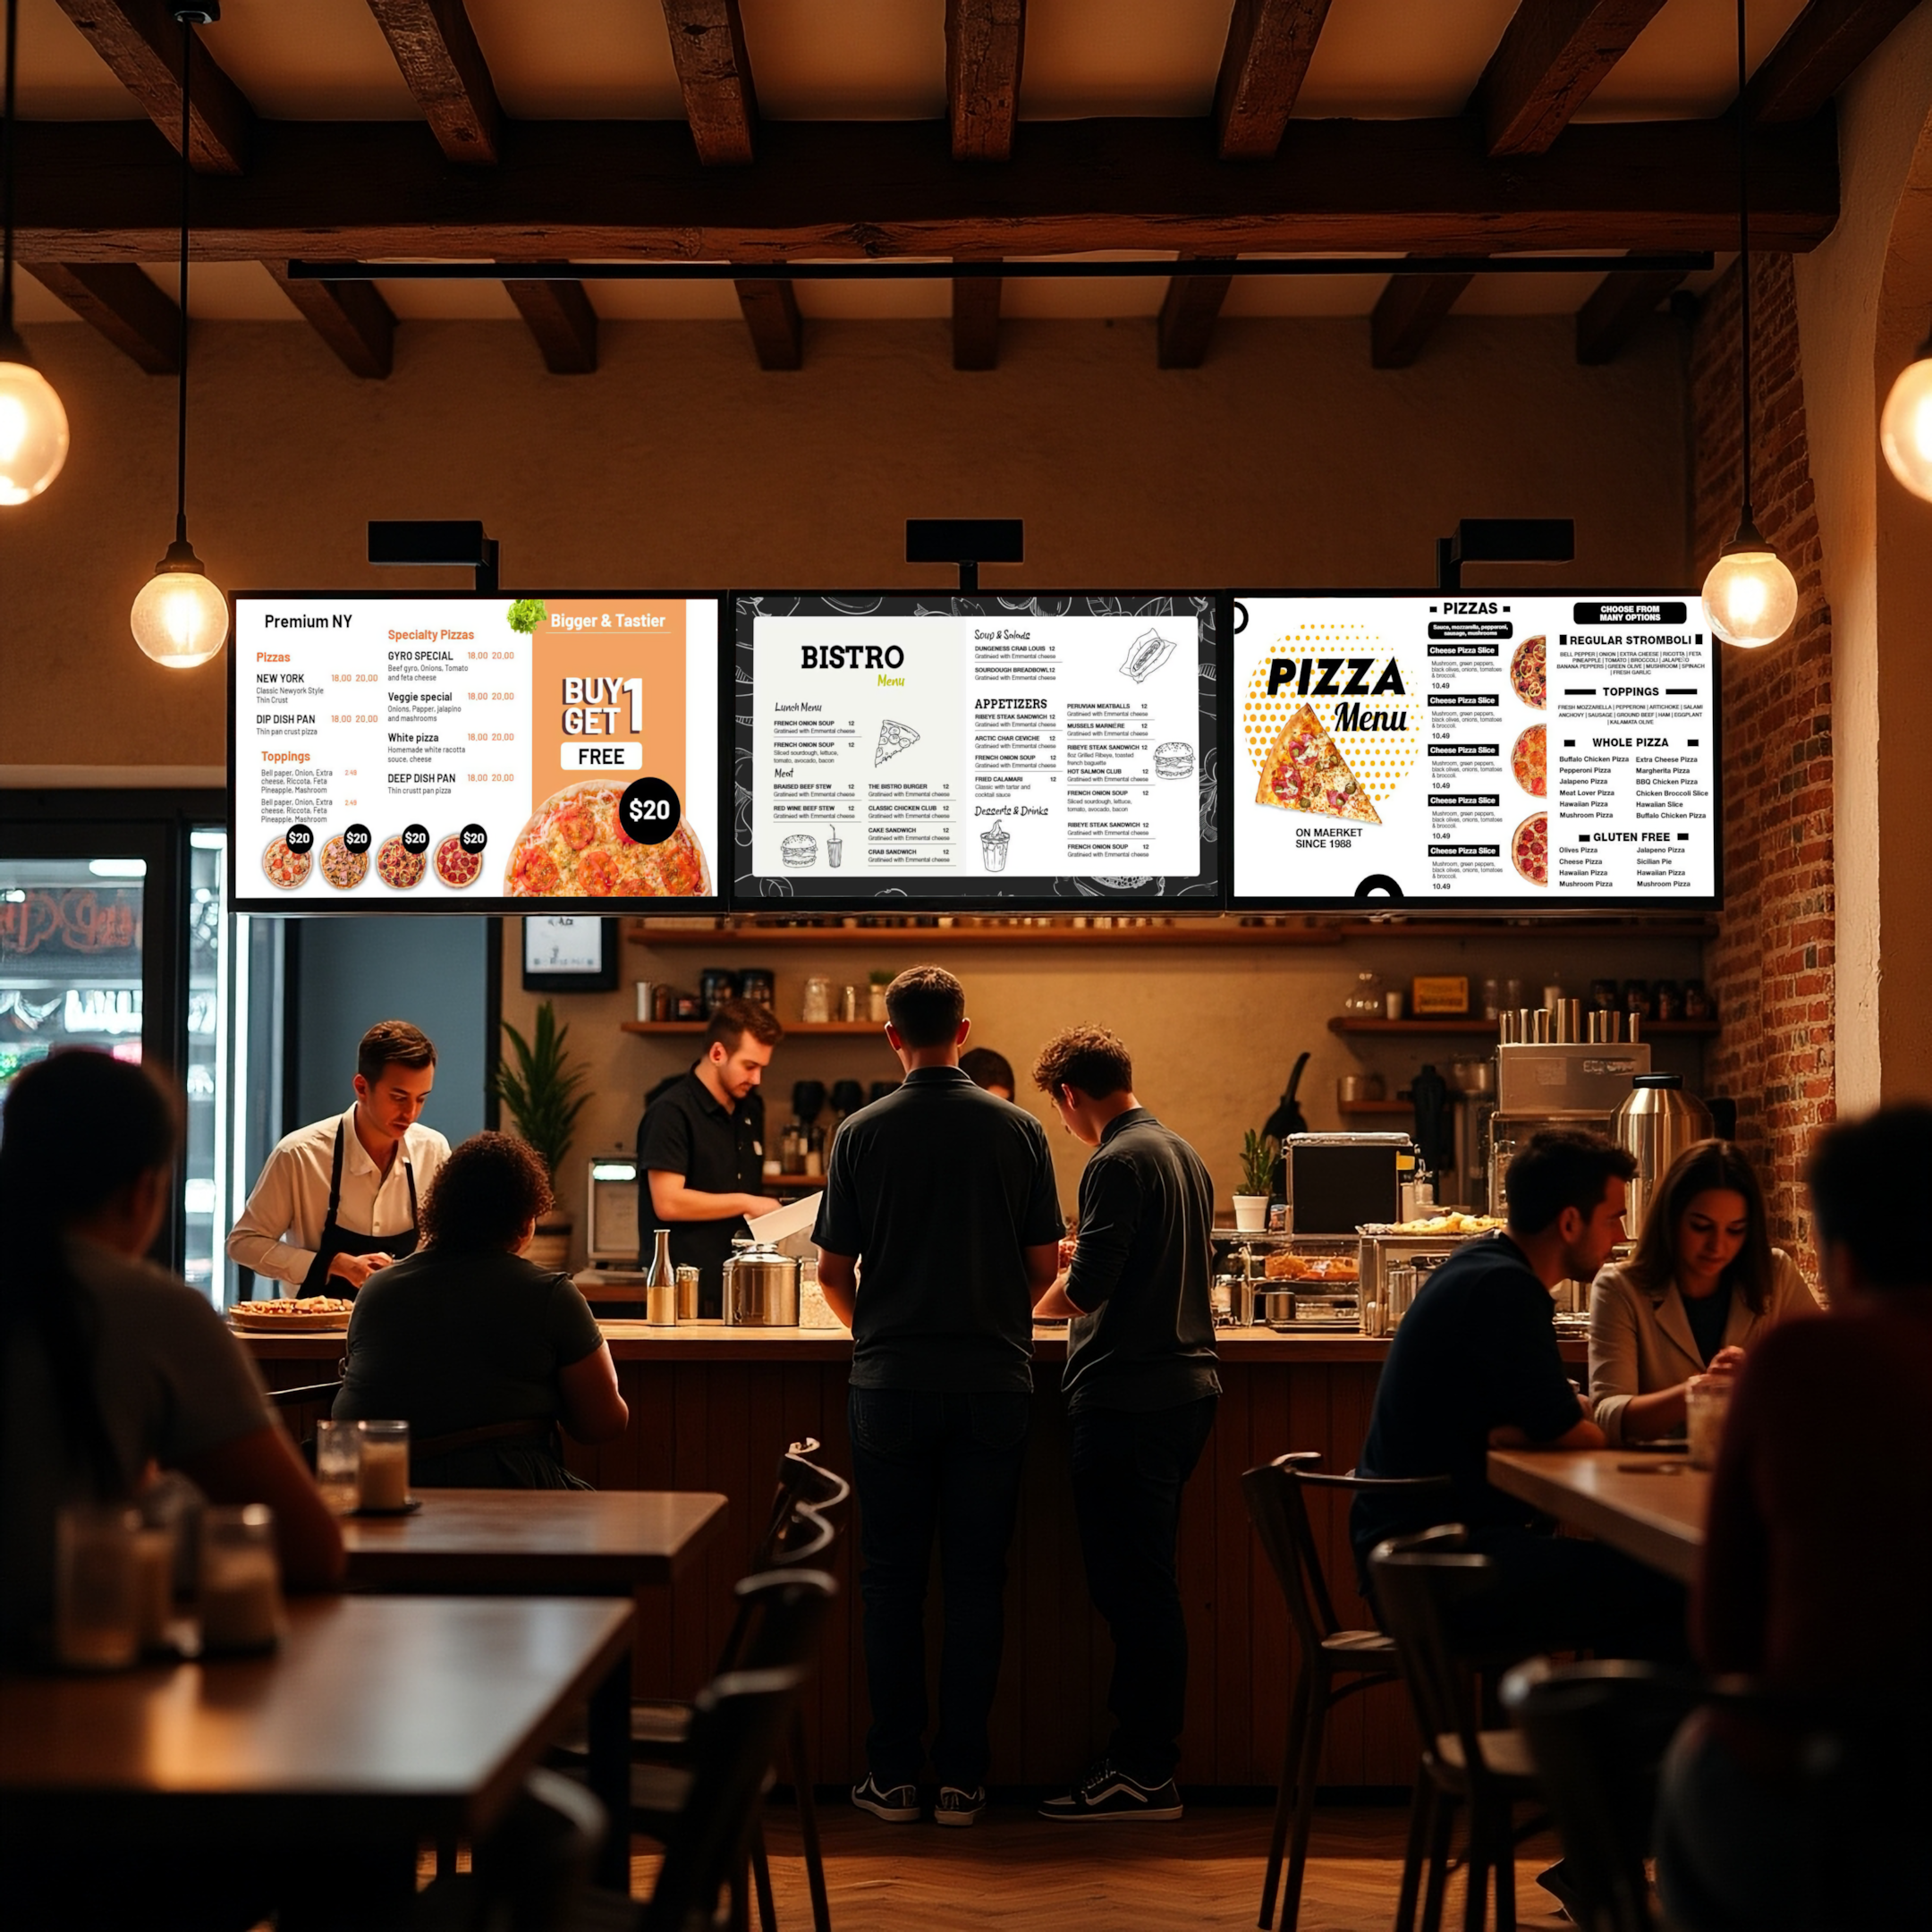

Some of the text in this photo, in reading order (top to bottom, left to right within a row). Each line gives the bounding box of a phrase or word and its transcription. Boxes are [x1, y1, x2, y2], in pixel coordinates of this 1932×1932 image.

[1444, 602, 1497, 614] PIZZAS
[1601, 605, 1660, 613] CHOOSE FROM
[266, 614, 352, 628] Premium NY
[1600, 613, 1661, 621] MANY OPTIONS
[551, 614, 665, 631] Bigger & Tastier
[388, 630, 474, 642] Specialty Pizzas
[975, 630, 1030, 640] Soup & Salads
[1571, 636, 1691, 645] REGULAR STROMBOLI
[1429, 646, 1495, 654] Cheese Pizza Slice
[257, 652, 290, 662] Pizzas
[388, 651, 513, 660] GYRO SPECIAL 18.00 20.00
[801, 645, 904, 669] BISTRO
[257, 674, 377, 682] NEW YORK 18.00 20.00
[388, 674, 436, 682] and feta cheese
[877, 674, 905, 686] Menu
[1267, 657, 1405, 695] PIZZA
[257, 686, 324, 695] Classic Newyork Style
[1432, 682, 1450, 690] 10.49
[1603, 687, 1659, 696] TOPPINGS
[257, 695, 288, 703] Thin Crust
[388, 692, 513, 703] Veggie special 18.00 20.00
[563, 677, 642, 733] BUY 1
[775, 702, 822, 712] Lunch Menu
[975, 699, 1046, 708] APPETIZERS
[257, 715, 377, 724] DIP DISH PAN 18.00 20.00
[562, 708, 621, 735] GET
[1334, 702, 1407, 732] Menu
[388, 733, 513, 744] White pizza 18.00 20.00
[1433, 732, 1450, 740] 10.49
[1592, 738, 1669, 747] WHOLE PIZZA
[388, 745, 423, 753] Homemade
[424, 745, 442, 753] white
[1430, 746, 1496, 754] Cheese Pizza Slice
[261, 751, 310, 764] Toppings
[580, 749, 624, 764] FREE
[1584, 755, 1610, 763] Chicken
[775, 768, 793, 777] Meat
[1560, 767, 1592, 775] Pepperoni
[1636, 767, 1690, 775] Margherita Pizza
[388, 774, 513, 783] DEEP DISH PAN 18.00 20.00
[1560, 777, 1589, 785] Jalapeno
[261, 786, 293, 794] Pineapple,
[1433, 782, 1450, 790] 10.49
[630, 798, 669, 822] $20
[975, 805, 1048, 816] Desserts & Drinks
[1296, 828, 1362, 837] ON MAERKET
[1433, 832, 1451, 840] 10.49
[289, 832, 309, 844] $20
[345, 832, 368, 845] $20
[405, 832, 426, 844] $20
[463, 832, 485, 844] $20
[1594, 833, 1670, 842] GLUTEN FREE
[1296, 839, 1352, 848] SINCE 1988
[1559, 846, 1597, 854] Olives Pizza
